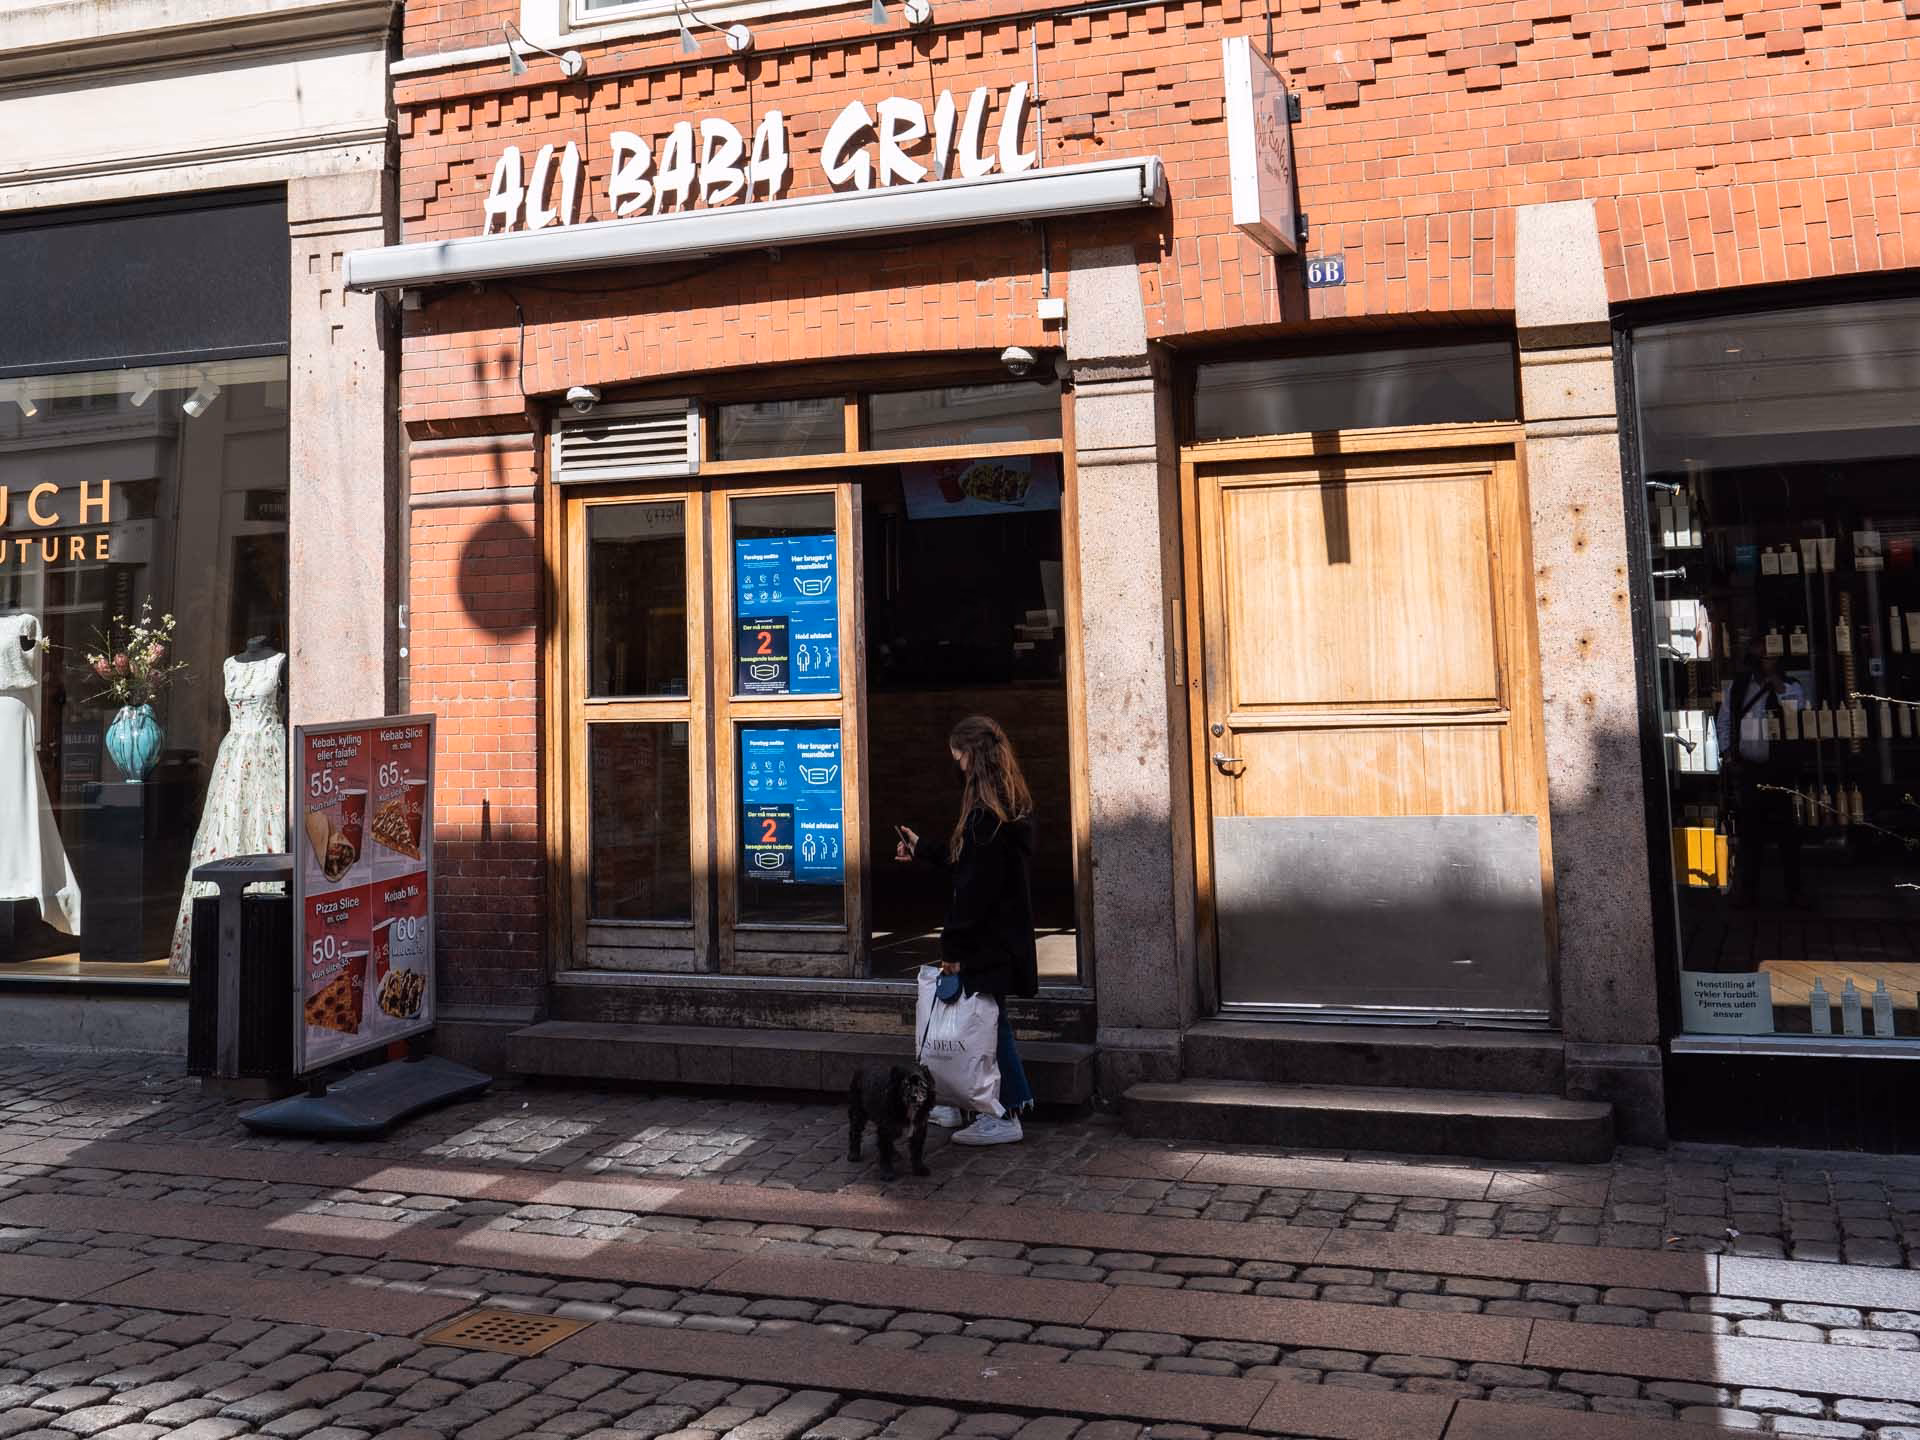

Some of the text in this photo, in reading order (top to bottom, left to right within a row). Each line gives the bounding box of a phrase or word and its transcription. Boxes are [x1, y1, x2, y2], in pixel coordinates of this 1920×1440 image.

[482, 80, 1037, 235] ALI BABA GRILL
[796, 562, 828, 570] mundbind
[757, 631, 772, 654] 2
[312, 735, 362, 749] Kebab, kylling
[380, 728, 423, 742] Kebab Slice
[317, 747, 357, 761] eller falafel
[810, 743, 832, 751] bruger
[379, 761, 410, 788] 65,-
[311, 769, 345, 797] 55,-
[761, 819, 777, 842] 2
[384, 885, 419, 903] Kebab Mix
[316, 897, 360, 916] Pizza Slice
[312, 935, 349, 965] 50,-
[1696, 980, 1744, 989] Henstilling
[1694, 990, 1720, 998] cykler
[1698, 1000, 1732, 1008] Fjernes
